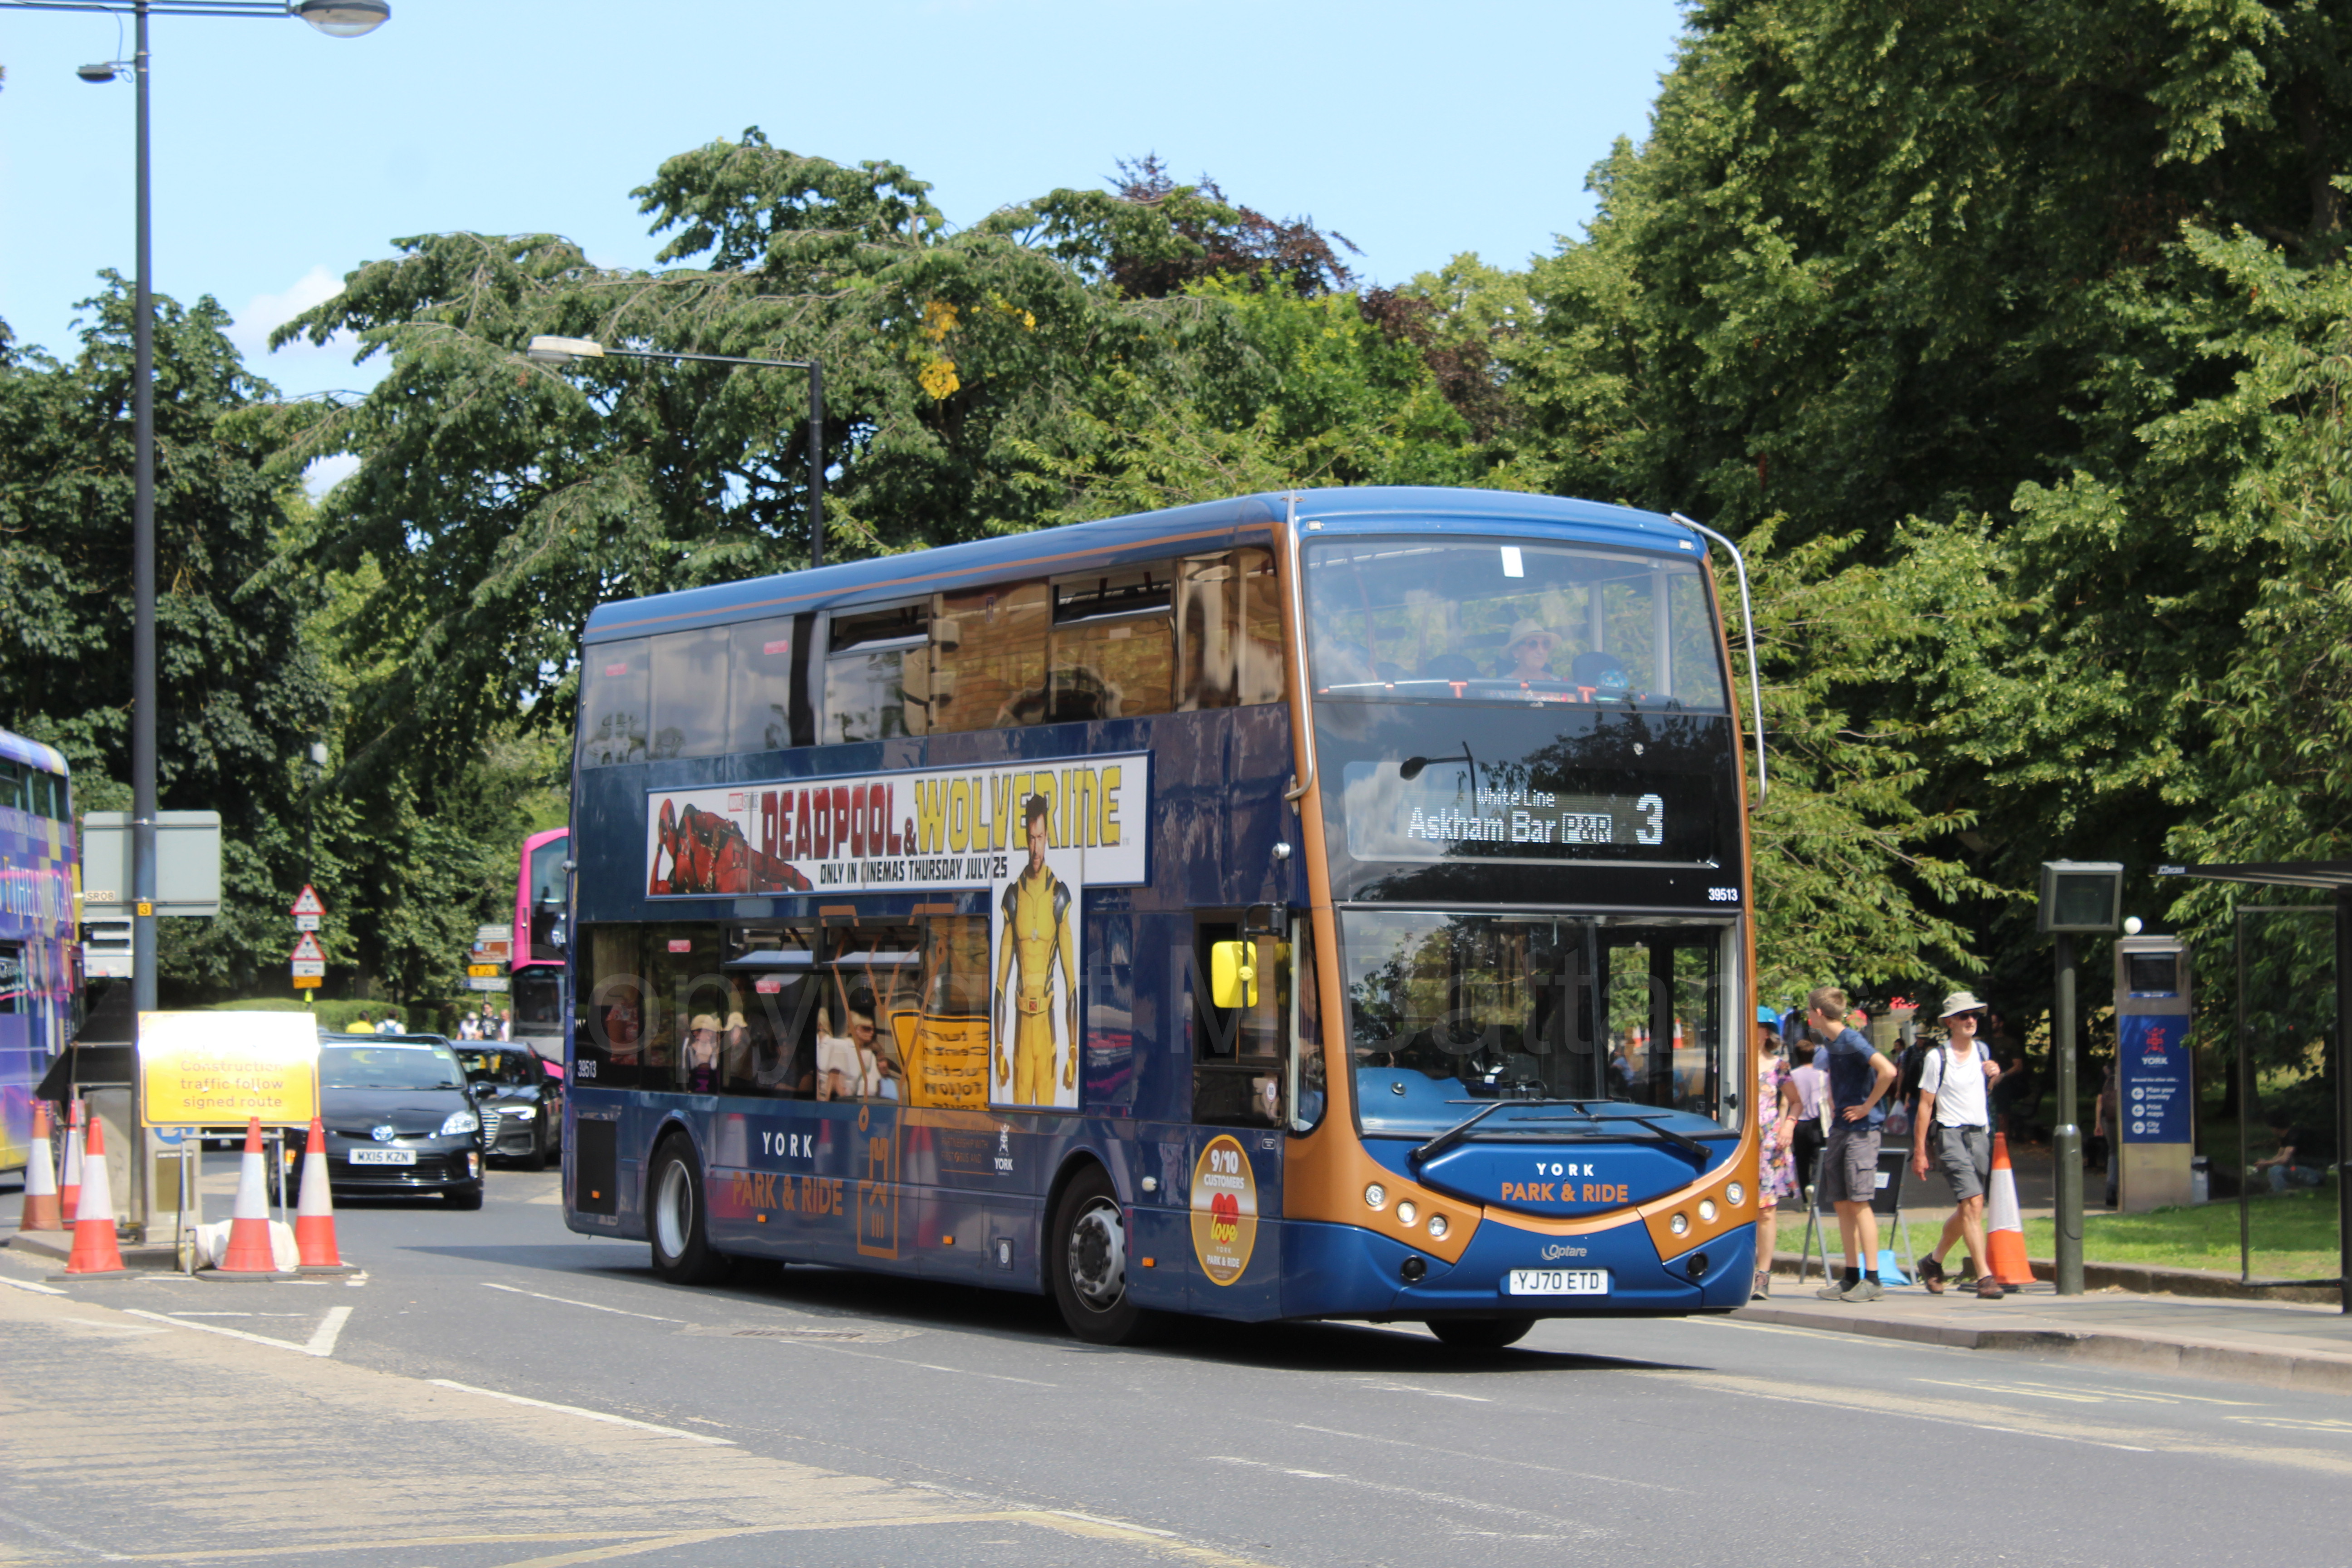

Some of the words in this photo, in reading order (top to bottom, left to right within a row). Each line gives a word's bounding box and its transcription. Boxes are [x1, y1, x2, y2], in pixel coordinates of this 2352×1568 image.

[1476, 787, 1520, 806] White
[1524, 789, 1556, 808] Line
[761, 782, 902, 861] DEADPOOL
[904, 816, 918, 857] &
[915, 765, 1122, 855] WOLVERINE
[1636, 794, 1664, 845] 3
[1408, 807, 1504, 842] Askham
[1511, 810, 1557, 843] Bar
[1563, 813, 1612, 844] P&R
[820, 863, 844, 885] ONLY
[848, 862, 857, 883] IN
[861, 861, 905, 883] CINEMAS
[909, 858, 962, 881] THURSDAY
[965, 858, 990, 880] JULY
[993, 856, 1008, 879] 25
[86, 892, 114, 901] SR08
[1708, 887, 1738, 901] 39513
[141, 904, 148, 915] 3
[181, 1060, 284, 1073] Construction
[577, 1059, 597, 1078] 39513
[2141, 1056, 2168, 1065] YORK
[181, 1078, 230, 1090] traffic
[235, 1078, 284, 1090] follow
[182, 1096, 235, 1110] signed
[240, 1097, 282, 1107] route
[762, 1132, 813, 1158] YORK
[386, 1151, 409, 1162] KZN
[994, 1157, 1013, 1171] YORK
[1210, 1149, 1239, 1174] 9/10
[1536, 1163, 1594, 1176] YORK
[1204, 1173, 1245, 1190] CUSTOMERS
[733, 1171, 778, 1210] PARK
[782, 1174, 796, 1211] &
[801, 1176, 843, 1216] RIDE
[1501, 1182, 1555, 1201] PARK
[1561, 1183, 1576, 1202] &
[1583, 1184, 1629, 1202] RIDE
[1210, 1214, 1238, 1242] love
[1216, 1246, 1232, 1254] YORK
[1548, 1244, 1588, 1259] Optare
[1206, 1254, 1221, 1266] PARK
[1222, 1256, 1226, 1266] &
[1227, 1257, 1240, 1268] RIDE
[1518, 1272, 1562, 1290] YJ70
[1567, 1272, 1599, 1290] ETD
